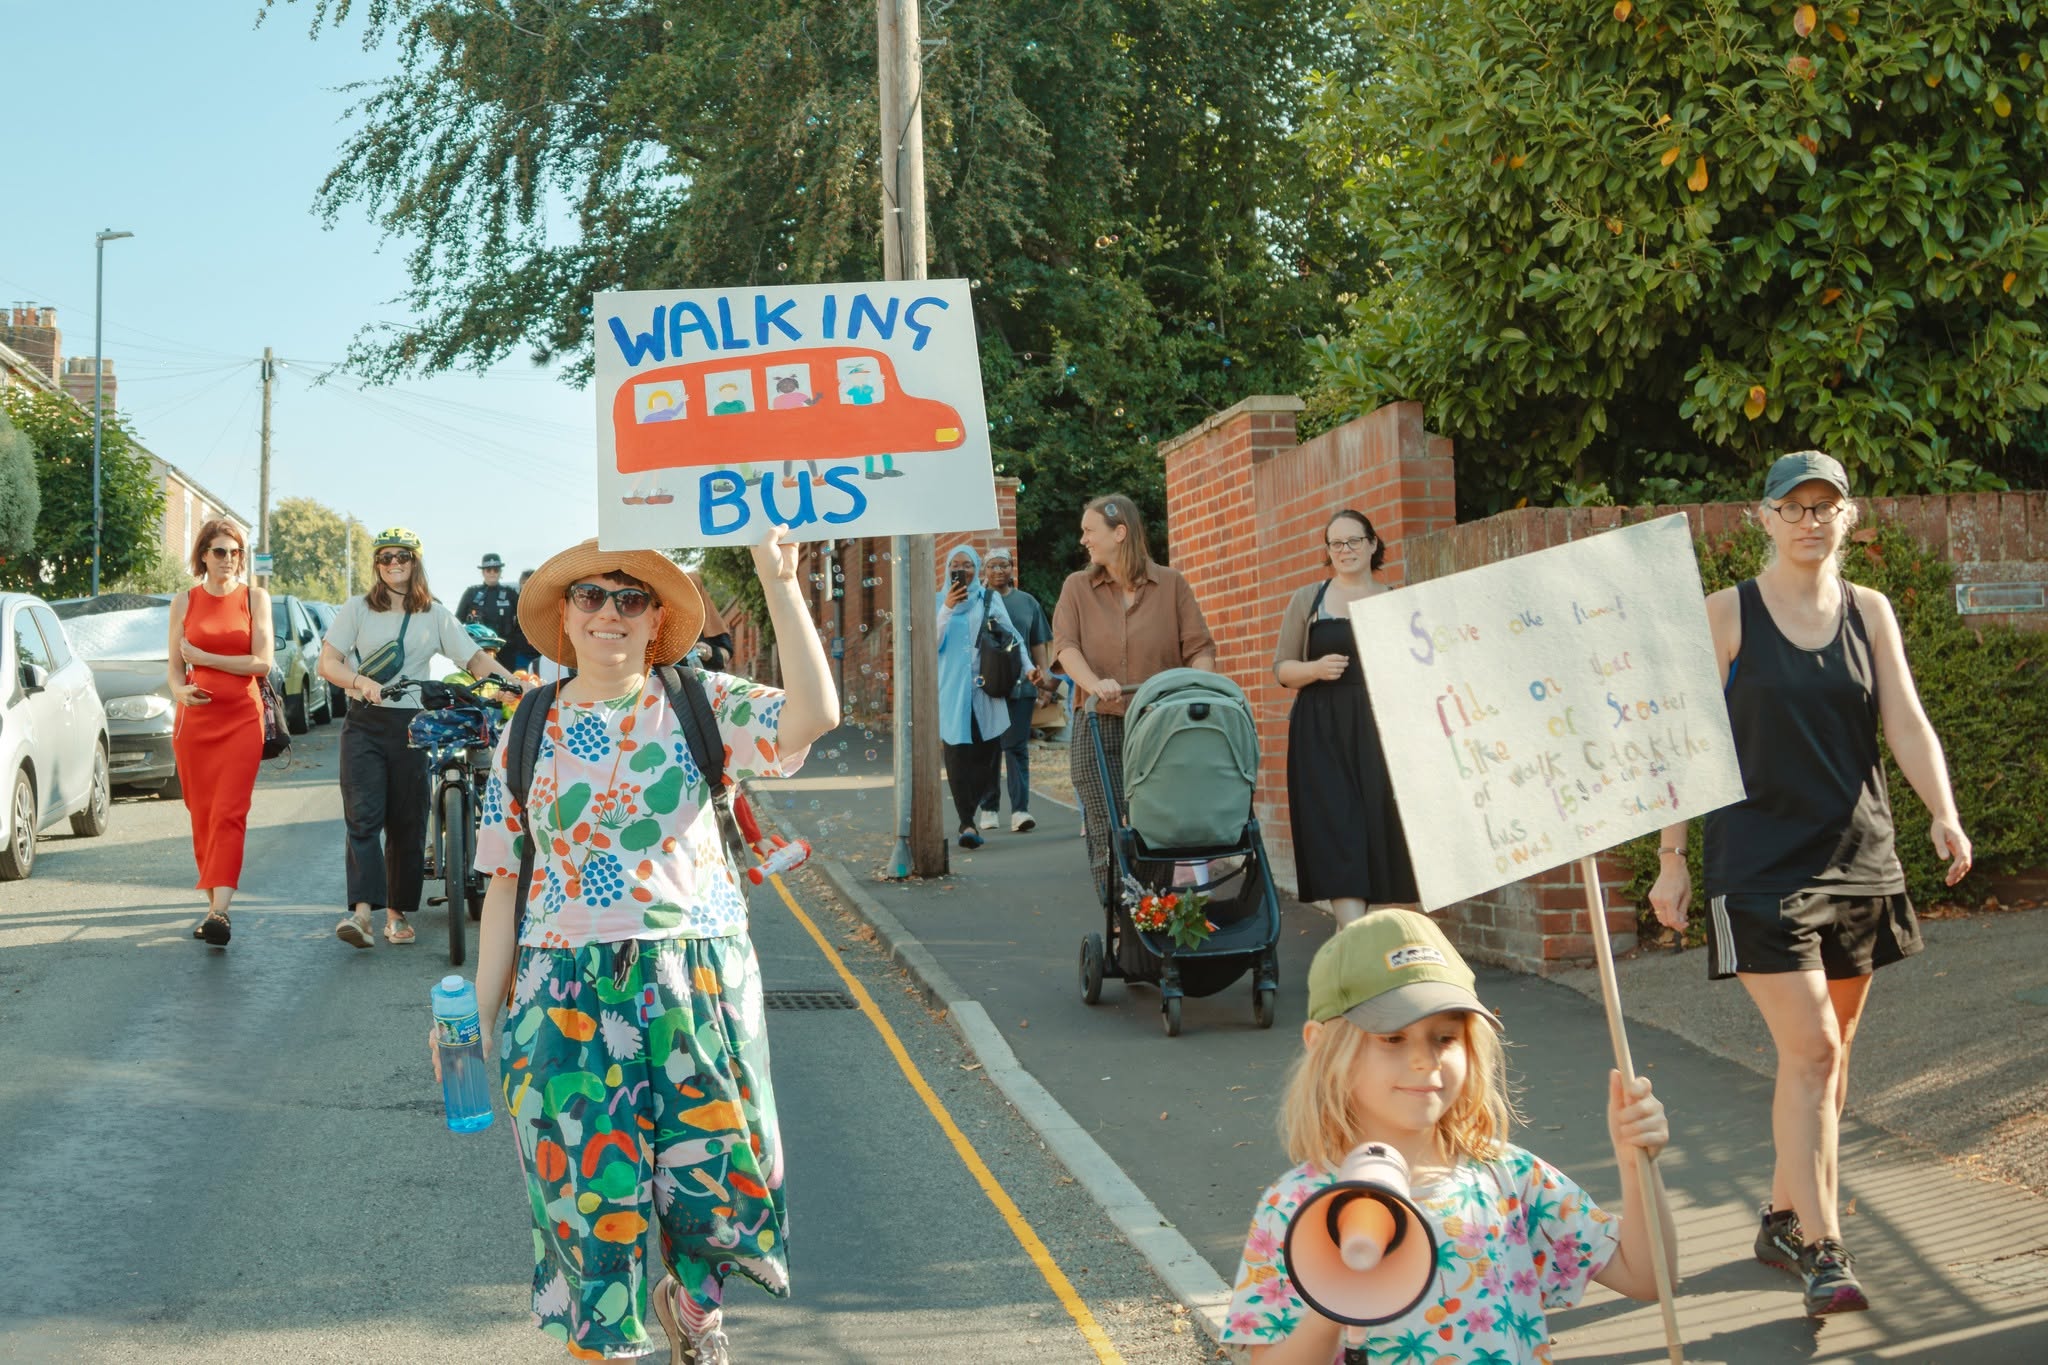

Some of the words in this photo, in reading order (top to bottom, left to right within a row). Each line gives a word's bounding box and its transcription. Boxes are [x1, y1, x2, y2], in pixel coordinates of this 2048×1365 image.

[607, 293, 949, 366] WALKING
[699, 466, 867, 536] BUS
[1436, 681, 1500, 738] ride
[1529, 677, 1562, 701] on
[1588, 651, 1632, 686] your
[1449, 735, 1511, 780] bike
[1548, 705, 1577, 737] or
[1474, 780, 1491, 808] or
[1483, 813, 1527, 850] bus
